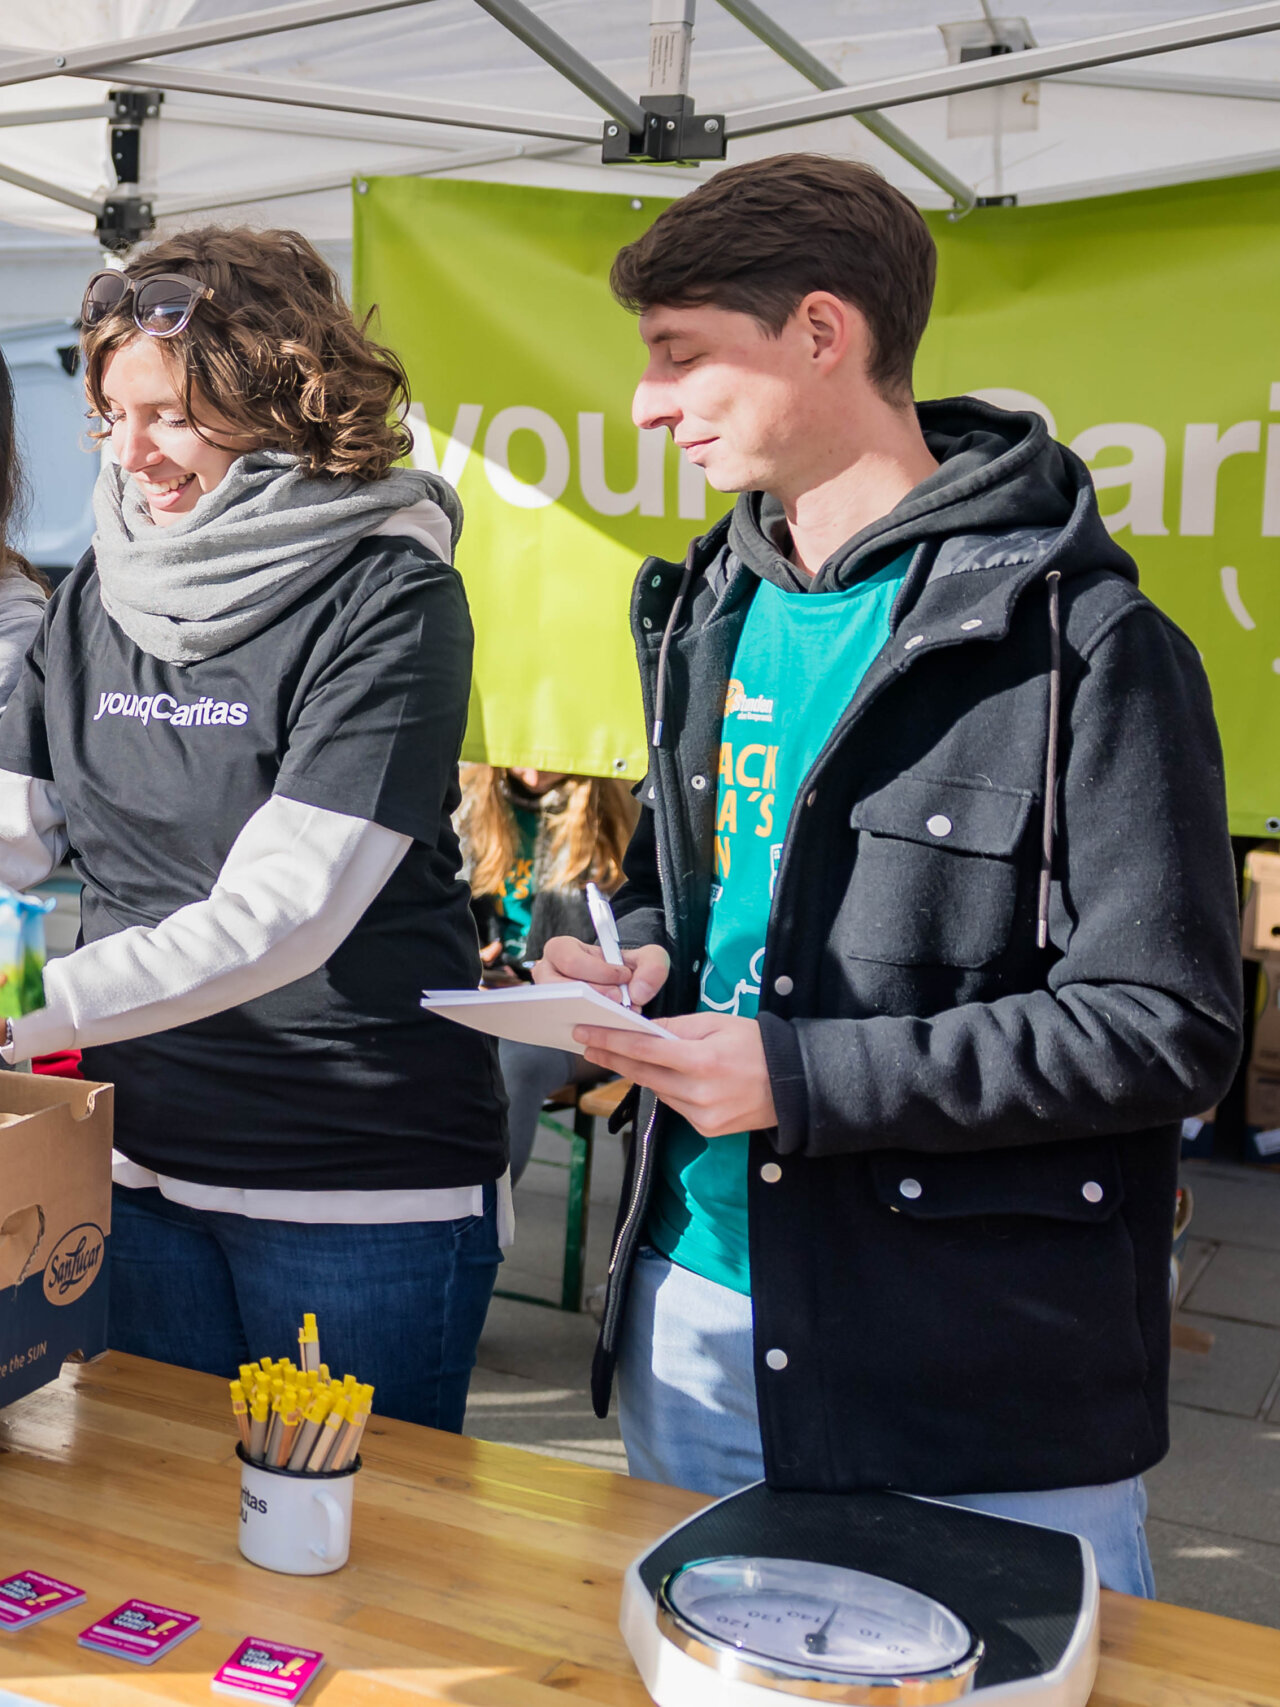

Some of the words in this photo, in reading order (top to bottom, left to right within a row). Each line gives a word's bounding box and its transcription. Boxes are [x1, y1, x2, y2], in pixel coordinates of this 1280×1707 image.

[47, 1236, 102, 1295] SanLucar
[9, 1355, 25, 1373] the
[27, 1341, 48, 1365] SUN
[859, 1627, 881, 1639] 10
